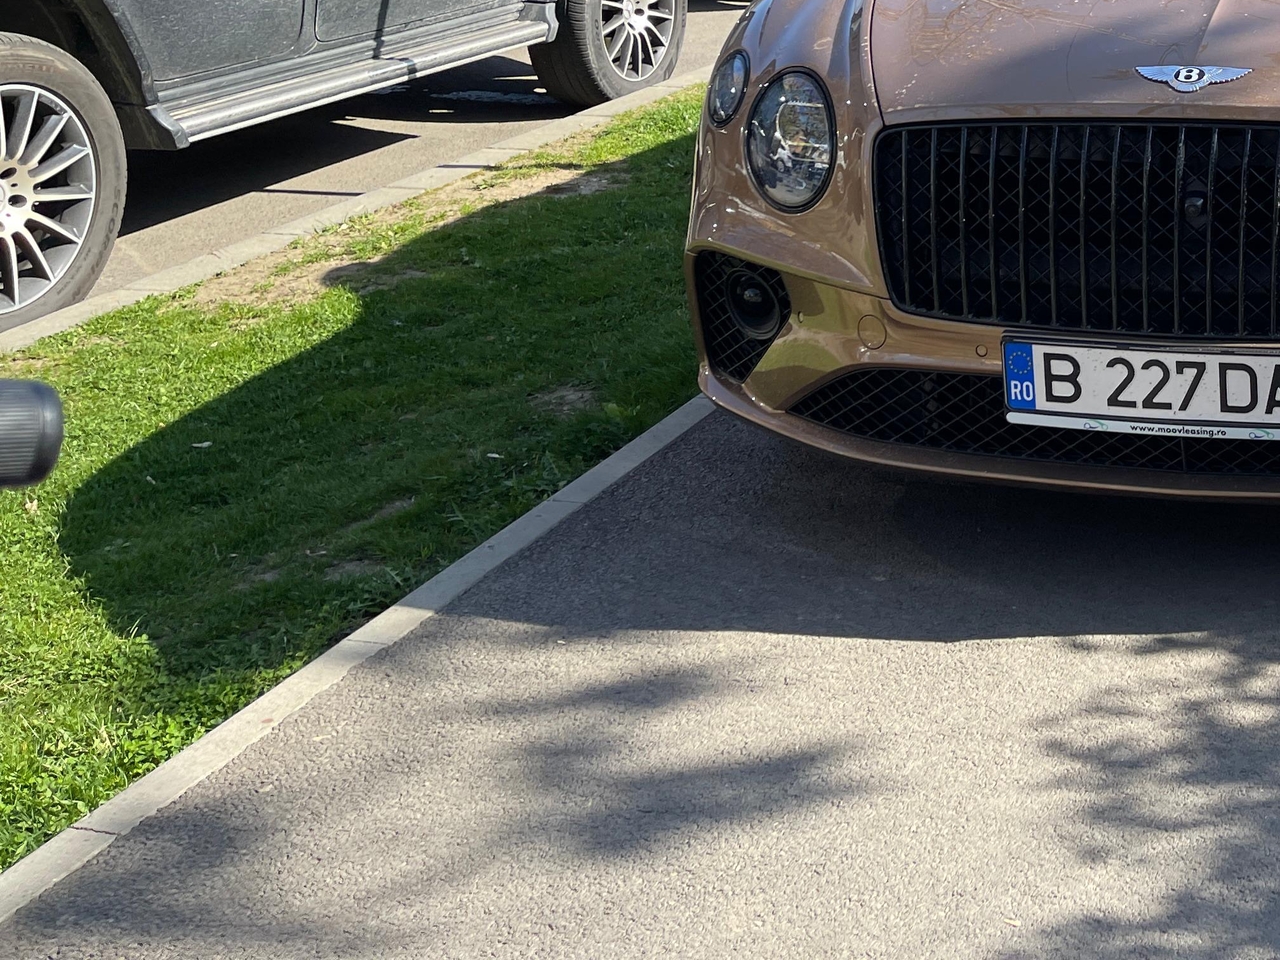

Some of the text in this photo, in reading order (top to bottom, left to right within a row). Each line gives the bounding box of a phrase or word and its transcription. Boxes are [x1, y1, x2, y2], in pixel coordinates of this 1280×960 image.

[1177, 68, 1200, 82] B
[1043, 352, 1082, 403] B
[1010, 380, 1034, 402] RO
[1130, 424, 1227, 437] www.moovleasing.ro
